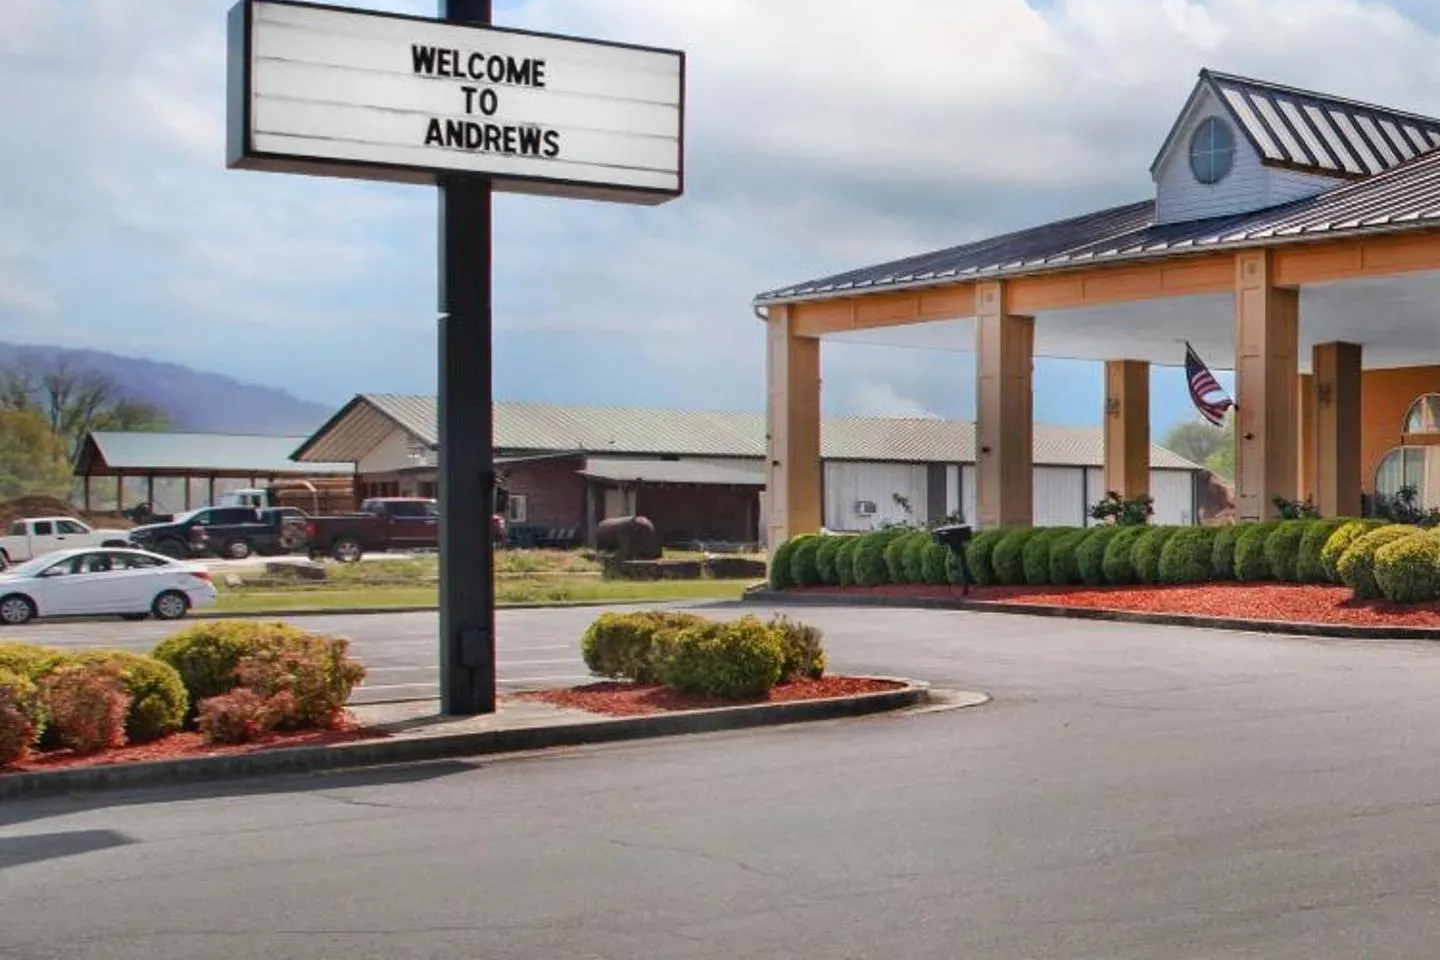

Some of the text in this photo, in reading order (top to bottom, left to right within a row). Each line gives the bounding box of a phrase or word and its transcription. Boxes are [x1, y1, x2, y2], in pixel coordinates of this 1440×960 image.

[411, 44, 546, 87] WELCOME
[461, 86, 498, 116] TO
[424, 118, 560, 157] ANDREWS
